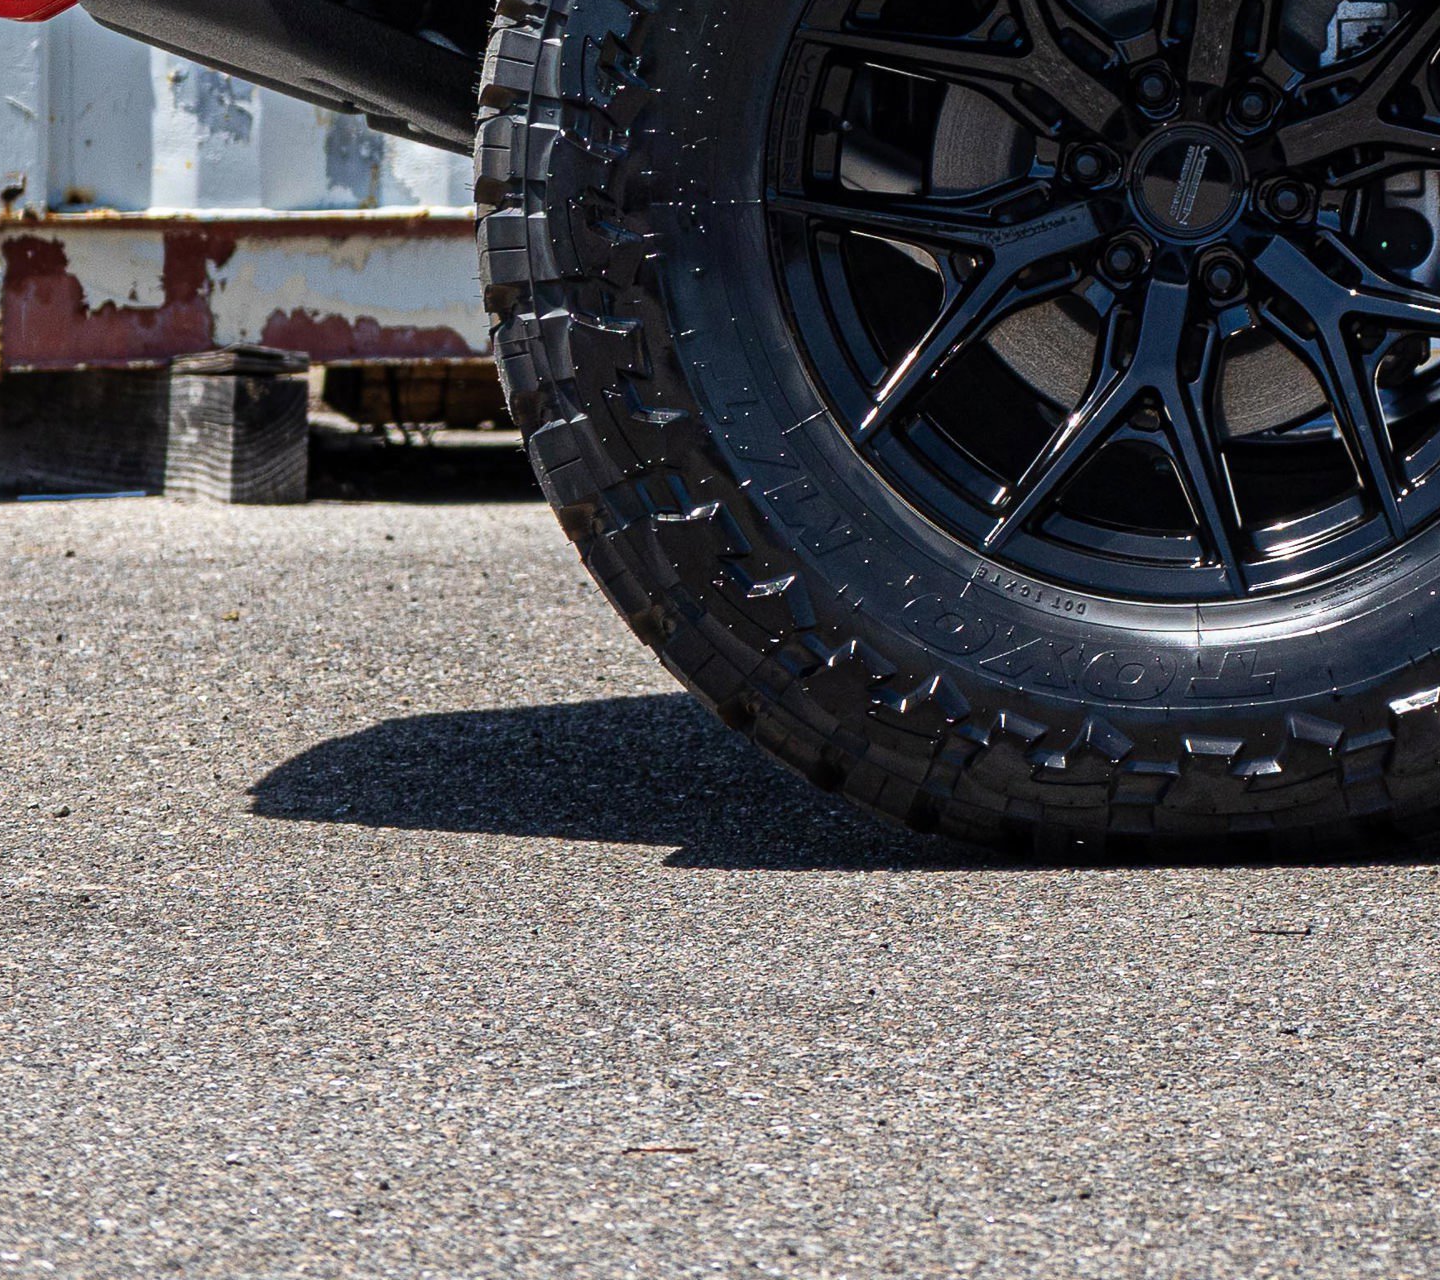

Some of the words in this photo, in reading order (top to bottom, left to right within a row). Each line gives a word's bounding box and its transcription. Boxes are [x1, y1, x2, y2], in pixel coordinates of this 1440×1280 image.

[1178, 145, 1211, 226] VOSSEN
[1051, 595, 1087, 615] DOT
[900, 593, 1278, 701] TOYO
